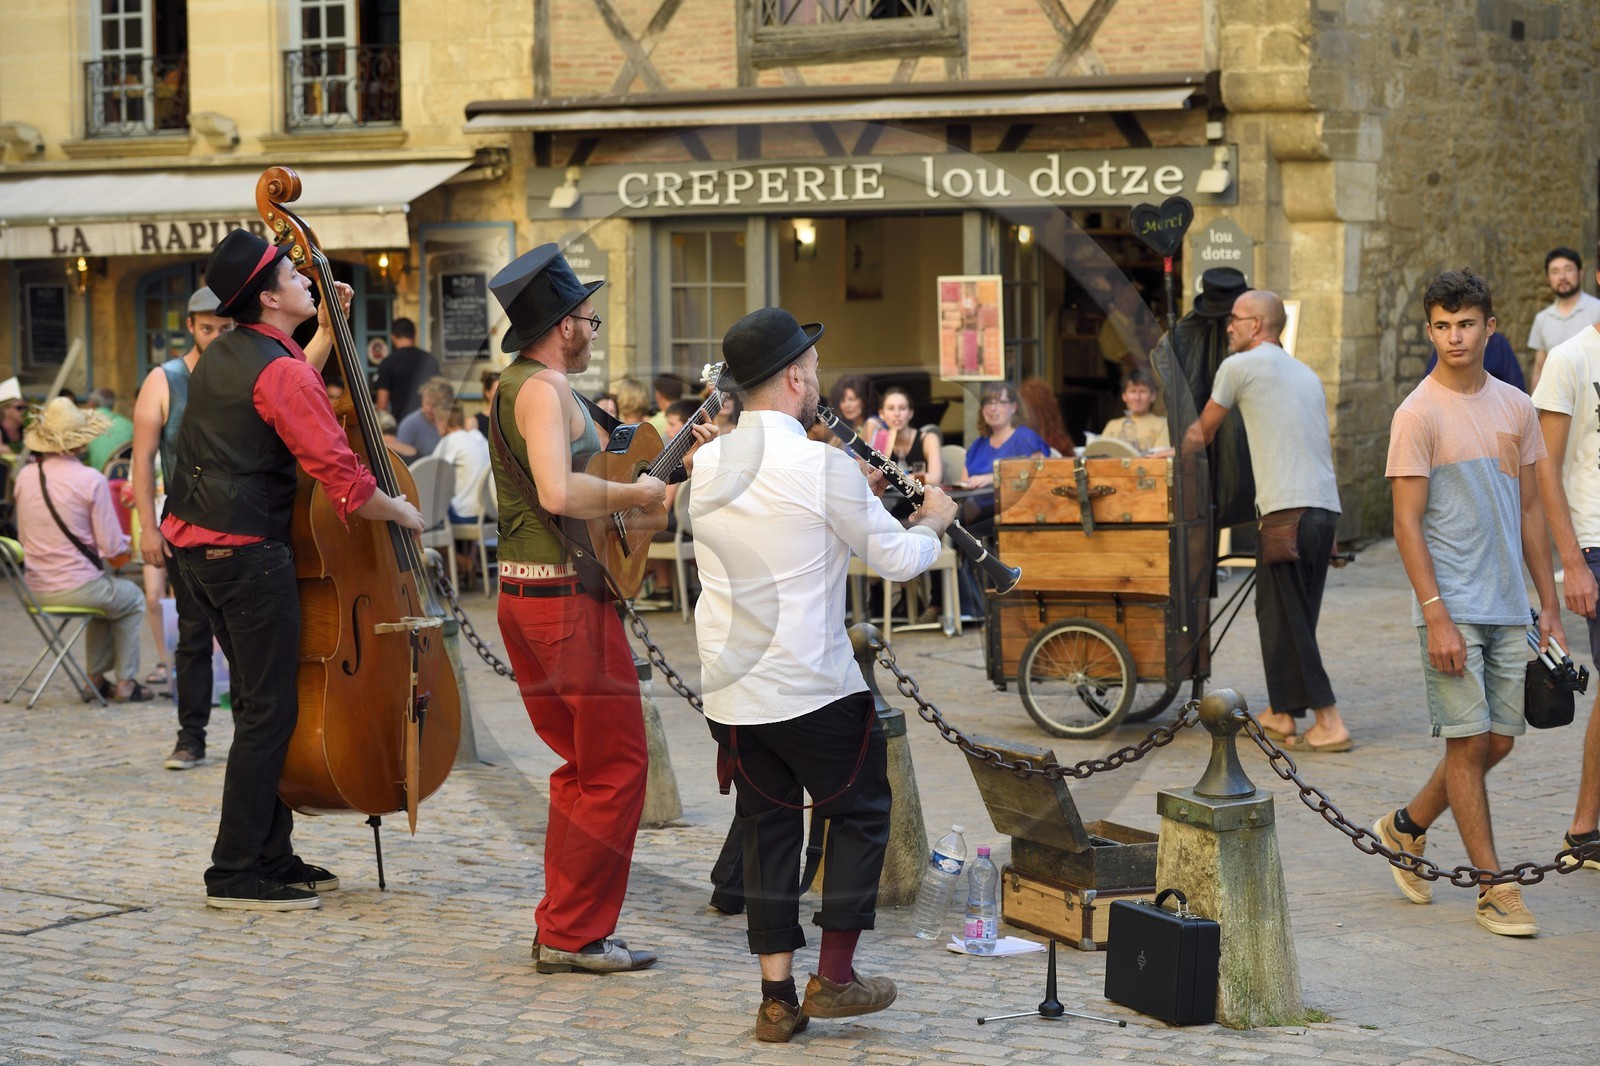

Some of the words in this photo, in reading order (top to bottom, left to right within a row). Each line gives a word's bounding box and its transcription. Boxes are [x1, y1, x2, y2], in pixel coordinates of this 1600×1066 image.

[617, 162, 885, 208] CREPERIE
[921, 155, 1012, 198] lou
[1028, 153, 1184, 197] dotze
[1142, 213, 1183, 234] Merci
[50, 227, 91, 253] LA
[1210, 229, 1233, 243] lou
[1201, 245, 1242, 261] dotze
